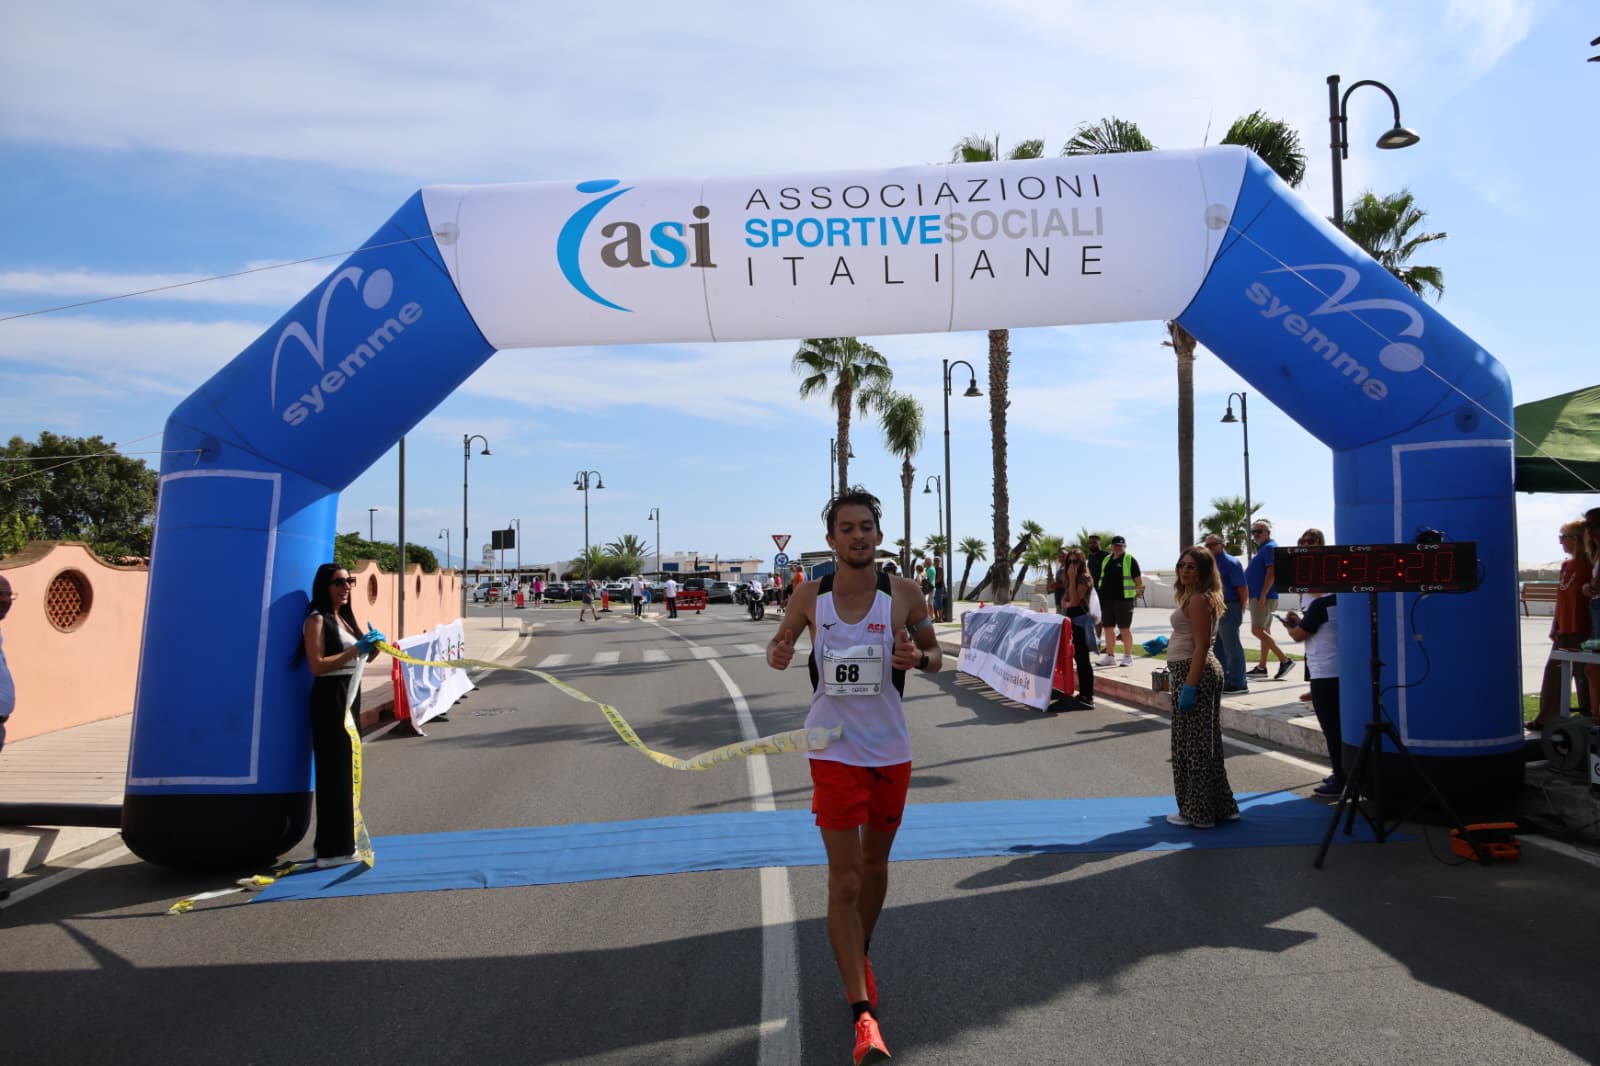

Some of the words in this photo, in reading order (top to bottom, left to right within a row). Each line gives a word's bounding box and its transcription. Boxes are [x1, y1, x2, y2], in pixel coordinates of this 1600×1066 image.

[745, 174, 1101, 211] ASSOCIAZIONI
[599, 204, 718, 270] asi
[747, 244, 1104, 287] ITALIANE
[282, 301, 424, 427] syemme
[1245, 281, 1389, 401] syemme
[835, 664, 860, 683] 68
